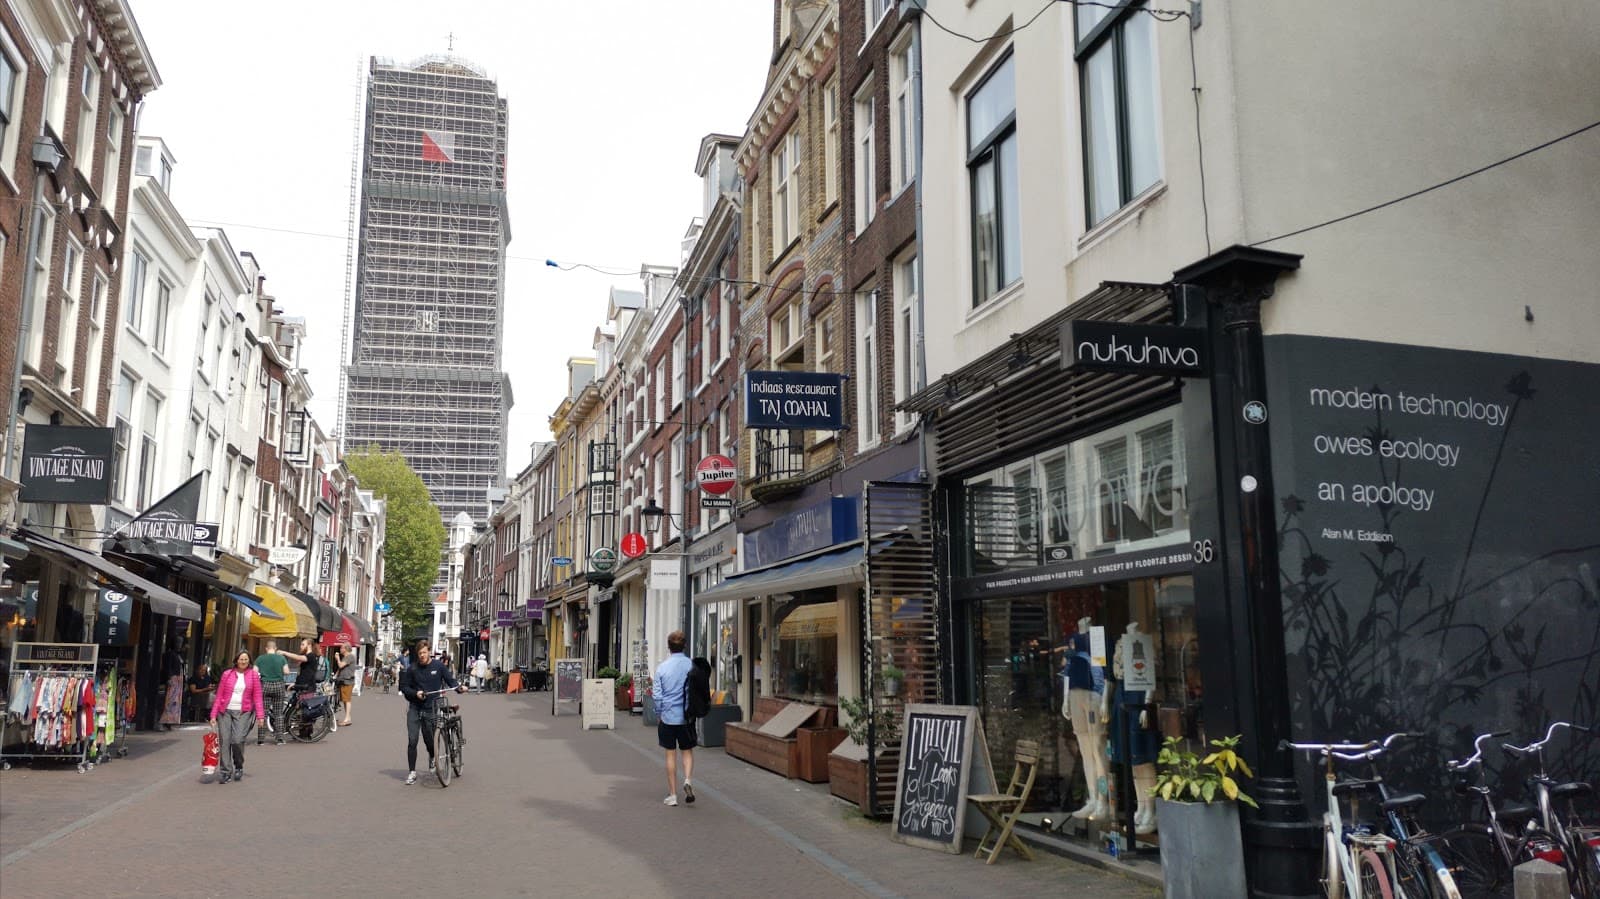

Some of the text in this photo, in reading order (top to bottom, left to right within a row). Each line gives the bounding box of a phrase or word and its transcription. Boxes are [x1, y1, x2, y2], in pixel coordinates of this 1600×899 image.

[1078, 335, 1199, 366] nukuhiva
[751, 380, 783, 393] indiaas
[759, 399, 831, 421] TAJ MAHAL
[1310, 387, 1509, 425] modern technology
[1314, 435, 1460, 466] owes ecology
[30, 457, 104, 480] VINTAGE ISLAND
[702, 470, 734, 480] Jupiler
[1318, 481, 1434, 511] an apology
[129, 521, 164, 538] VINTAGE
[165, 523, 194, 542] ISLAND
[1321, 527, 1342, 539] Alan
[1193, 539, 1213, 564] 36
[1067, 569, 1084, 578] STYLE
[1098, 562, 1125, 574] CONCEPT
[1125, 560, 1134, 570] BY
[1135, 556, 1168, 568] FLOORTJE
[908, 717, 962, 770] ETHICAL
